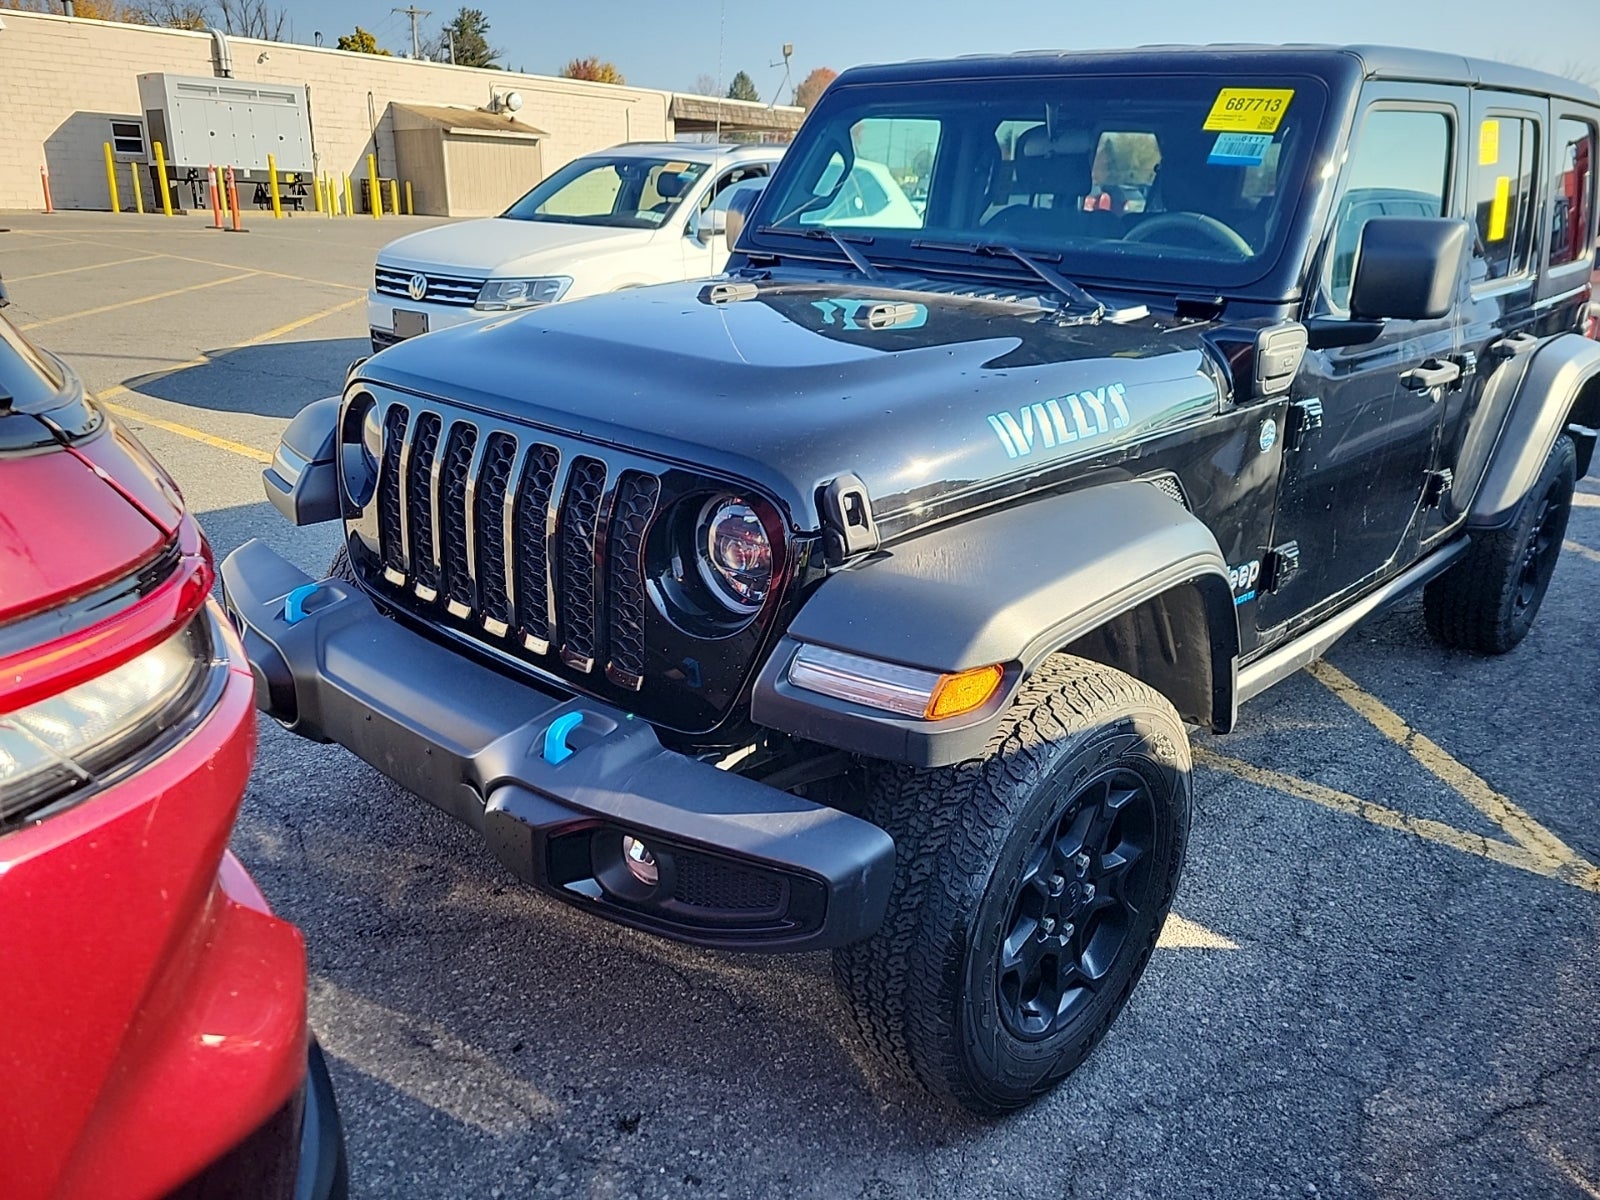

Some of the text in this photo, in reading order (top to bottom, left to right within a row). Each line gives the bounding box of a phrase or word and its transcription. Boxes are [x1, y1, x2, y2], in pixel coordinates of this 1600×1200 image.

[1225, 97, 1283, 113] 687713
[986, 382, 1131, 459] WILLYS
[1226, 560, 1260, 591] eep
